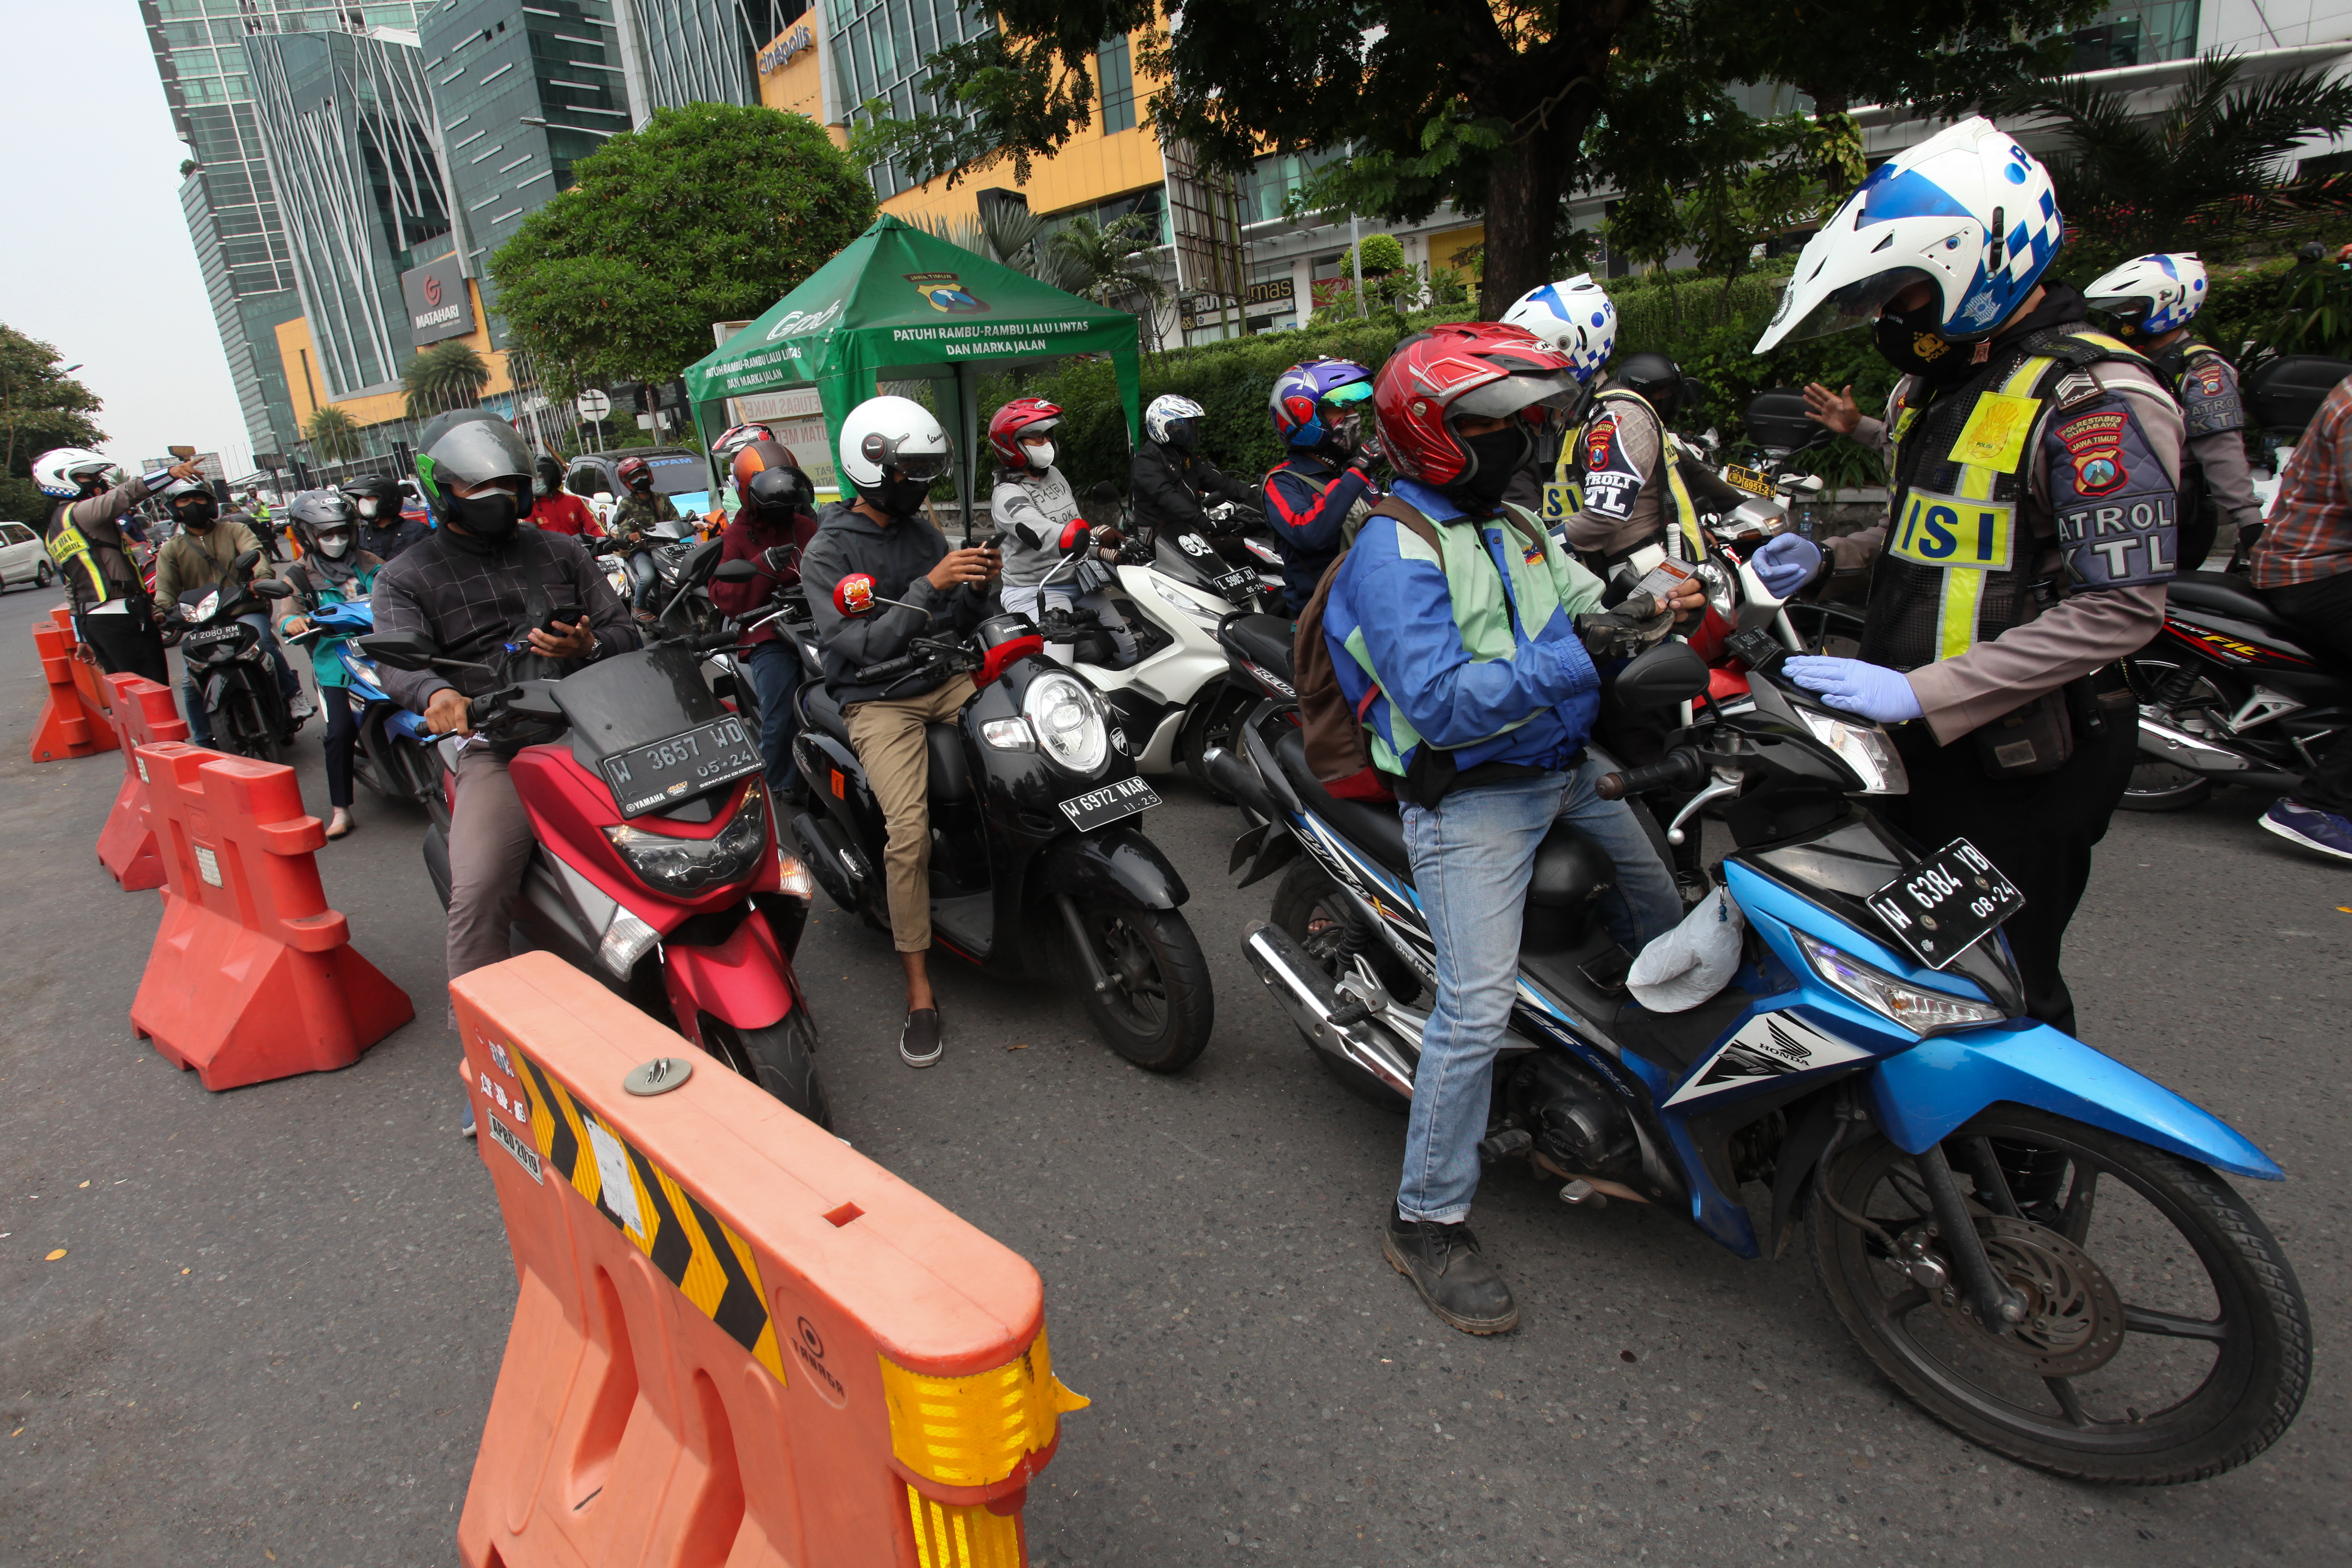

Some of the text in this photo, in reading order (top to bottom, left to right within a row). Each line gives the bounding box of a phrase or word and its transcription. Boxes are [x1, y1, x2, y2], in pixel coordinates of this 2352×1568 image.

[2008, 145, 2032, 172] P
[1243, 280, 1292, 303] mas
[1195, 295, 1238, 313] BUTK
[416, 304, 459, 329] MATAHARI
[767, 299, 841, 340] Grab
[894, 321, 1088, 341] PATUHI RAMBU-RAMBU LALU LINTAS
[946, 339, 1046, 355] DAN MARKA JALAN
[1925, 345, 1952, 363] POLRI
[706, 365, 724, 379] PATUH
[723, 357, 766, 374] RAMBU-RAMBU
[767, 352, 781, 365] LALU
[727, 369, 783, 389] DAN MARKA JALAN
[1439, 380, 1470, 397] comfortable
[2063, 387, 2099, 406] POLISI
[2060, 416, 2123, 436] POLRESTABES
[2066, 422, 2117, 439] SURABAYA
[927, 433, 943, 445] Vespa
[2072, 435, 2117, 452] JAWA TIMUR
[648, 458, 693, 467] OPAM
[1758, 474, 1764, 483] X
[1217, 569, 1256, 590] L 5905 JX
[200, 628, 222, 639] 2080
[225, 625, 239, 633] RM
[1003, 624, 1028, 634] HONDA
[2169, 620, 2212, 636] REVO
[350, 638, 359, 647] W
[2201, 635, 2263, 656] Fit
[1254, 667, 1297, 697] REVO
[349, 691, 365, 703] HONDA
[611, 723, 744, 783] W 3657 WD
[634, 793, 666, 810] YAMAHA
[739, 762, 762, 774] DEPAN
[1063, 778, 1148, 817] W 6972 NAR
[1877, 845, 1990, 930] W 6384 YB
[1394, 941, 1413, 964] One
[1759, 1042, 1811, 1067] HONDA
[492, 1118, 539, 1175] APBD 2019
[1543, 1132, 1583, 1158] HONDA
[791, 1336, 845, 1398] TANAGA
